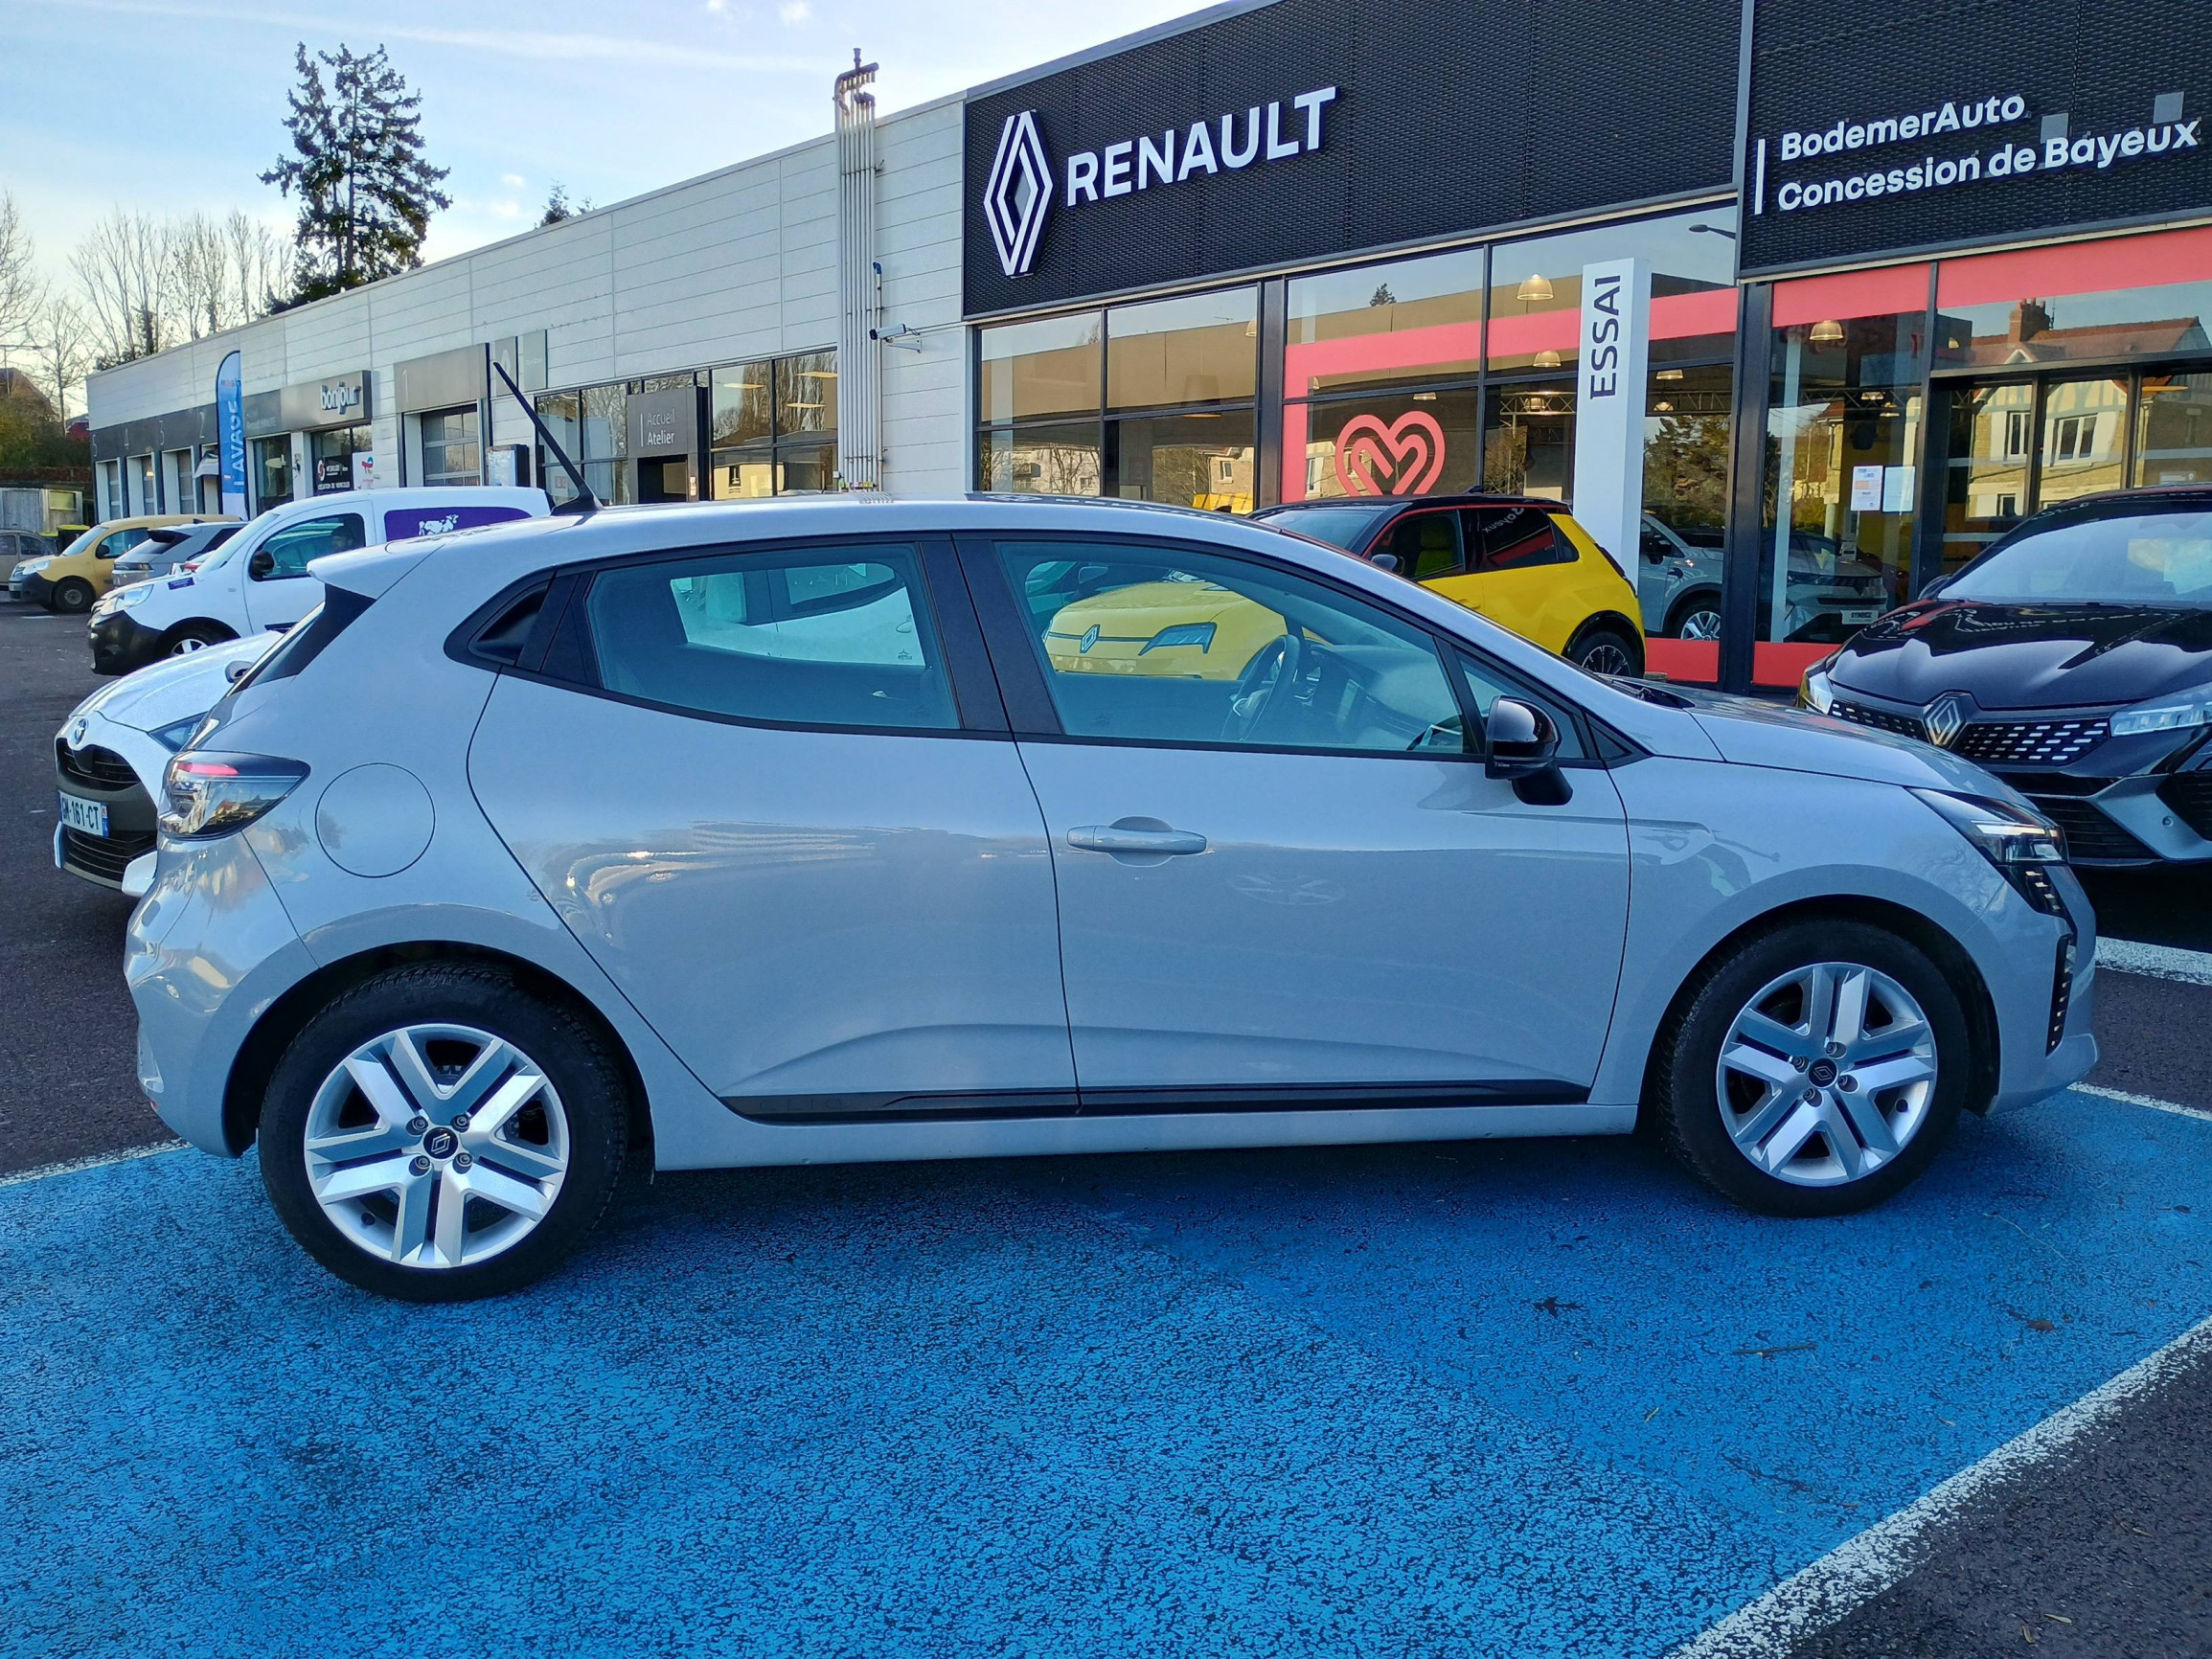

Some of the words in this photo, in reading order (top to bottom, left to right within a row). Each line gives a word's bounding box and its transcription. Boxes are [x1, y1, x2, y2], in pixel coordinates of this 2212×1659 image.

[1067, 86, 1338, 207] RENAULT
[1781, 94, 2027, 161] BodemerAuto
[1778, 154, 1980, 211] Concession
[1988, 143, 2037, 176] de
[2044, 118, 2201, 169] Bayeux
[1590, 275, 1621, 400] ESSAI
[320, 381, 361, 415] bonjour
[647, 408, 675, 426] Accueil
[647, 430, 675, 446] Atelier
